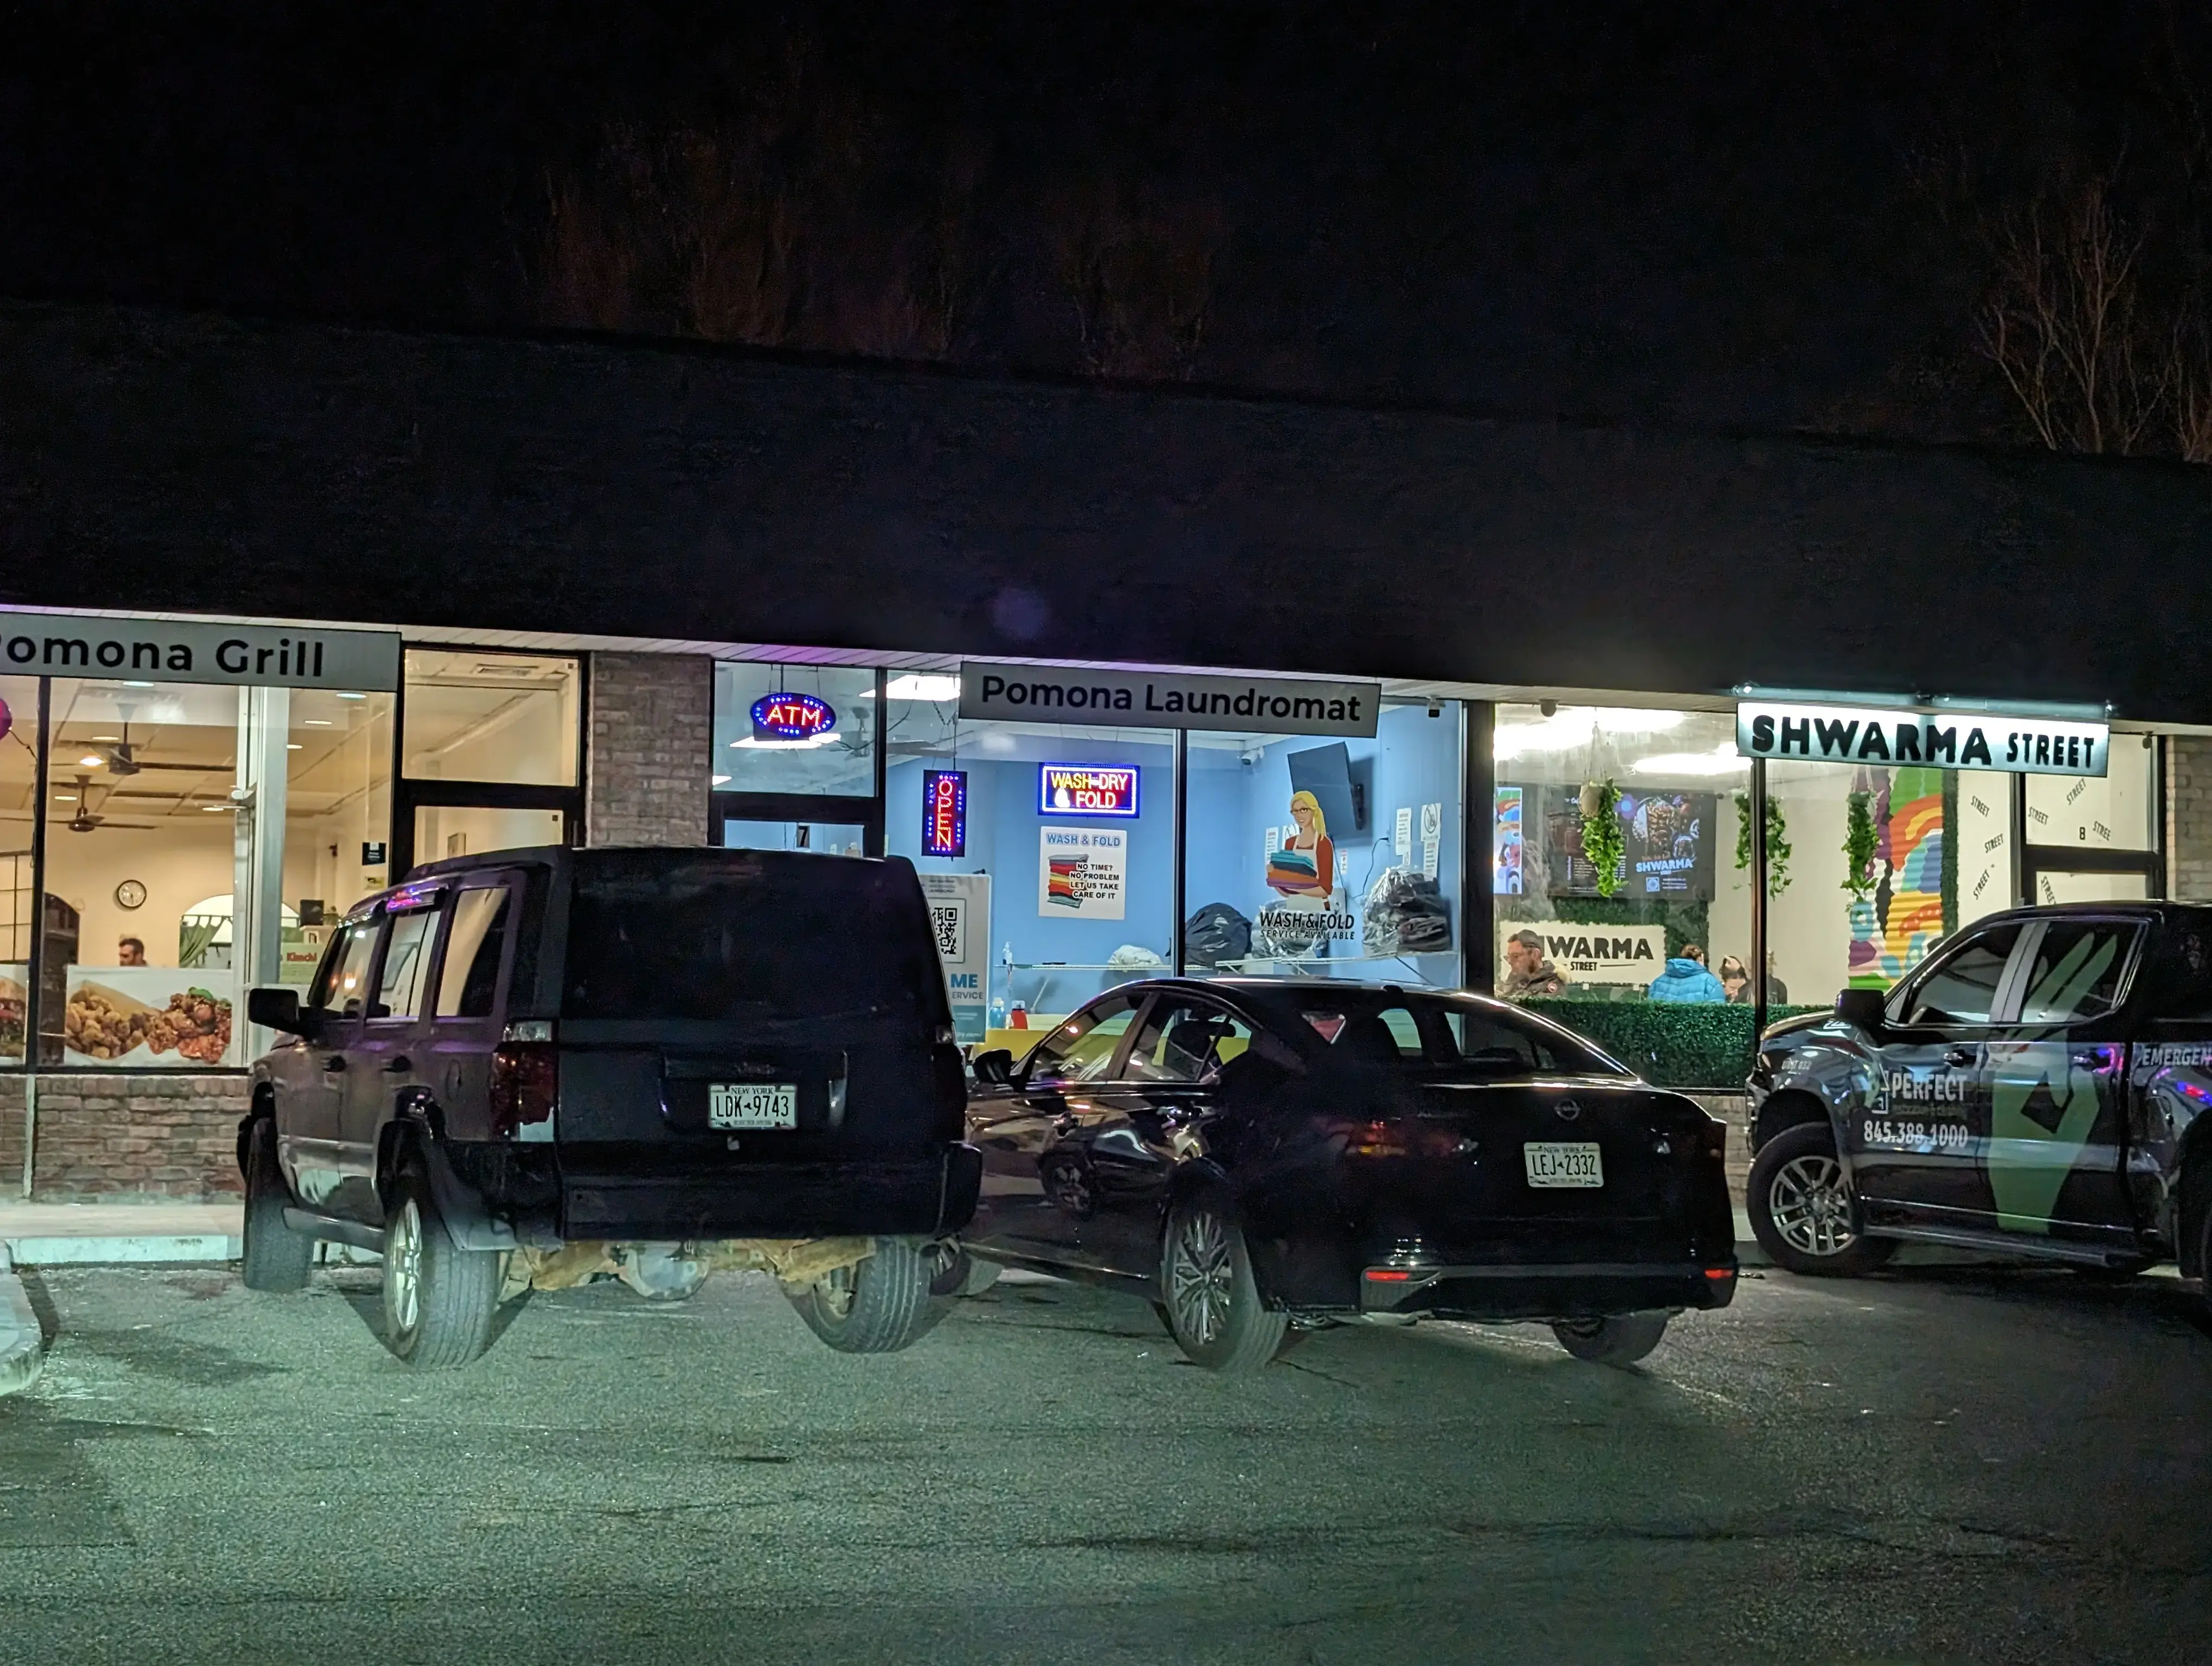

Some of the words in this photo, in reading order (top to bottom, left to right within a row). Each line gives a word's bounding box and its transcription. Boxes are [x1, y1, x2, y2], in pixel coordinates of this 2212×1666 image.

[0, 634, 192, 671] omona
[216, 638, 323, 677] Grill
[982, 675, 1133, 710] Pomona
[1146, 684, 1360, 721] Laundromat
[767, 704, 821, 727] ATM
[1752, 714, 1992, 766] SHWARMA
[2006, 732, 2094, 768] STREET
[1050, 772, 1129, 791] WASH-DRY
[2066, 778, 2087, 806] STREET
[1075, 791, 1117, 809] FOLD
[1971, 796, 1990, 818] STREET
[936, 780, 953, 848] OPEN
[2028, 806, 2049, 831] STREET
[798, 825, 808, 847] 7
[1047, 834, 1078, 844] WASH
[1082, 835, 1089, 845] &
[1093, 836, 1121, 847] FOLD
[2079, 826, 2086, 840] 8
[2092, 820, 2111, 841] STREE
[1984, 833, 2003, 854] STREET
[1635, 858, 1694, 873] SHWARMA
[1973, 869, 1990, 900] STREET
[1260, 912, 1302, 927] WASH
[1306, 913, 1315, 928] &
[1319, 914, 1355, 930] FOLD
[1261, 930, 1300, 938] SERVICE
[1304, 931, 1355, 940] AVAILABLE
[1538, 935, 1655, 960] WARMA
[1570, 962, 1598, 971] STREET
[952, 991, 983, 999] ERVICE
[1892, 1072, 1968, 1101] PERFECT
[1863, 1120, 1969, 1148] 845.388.1000
